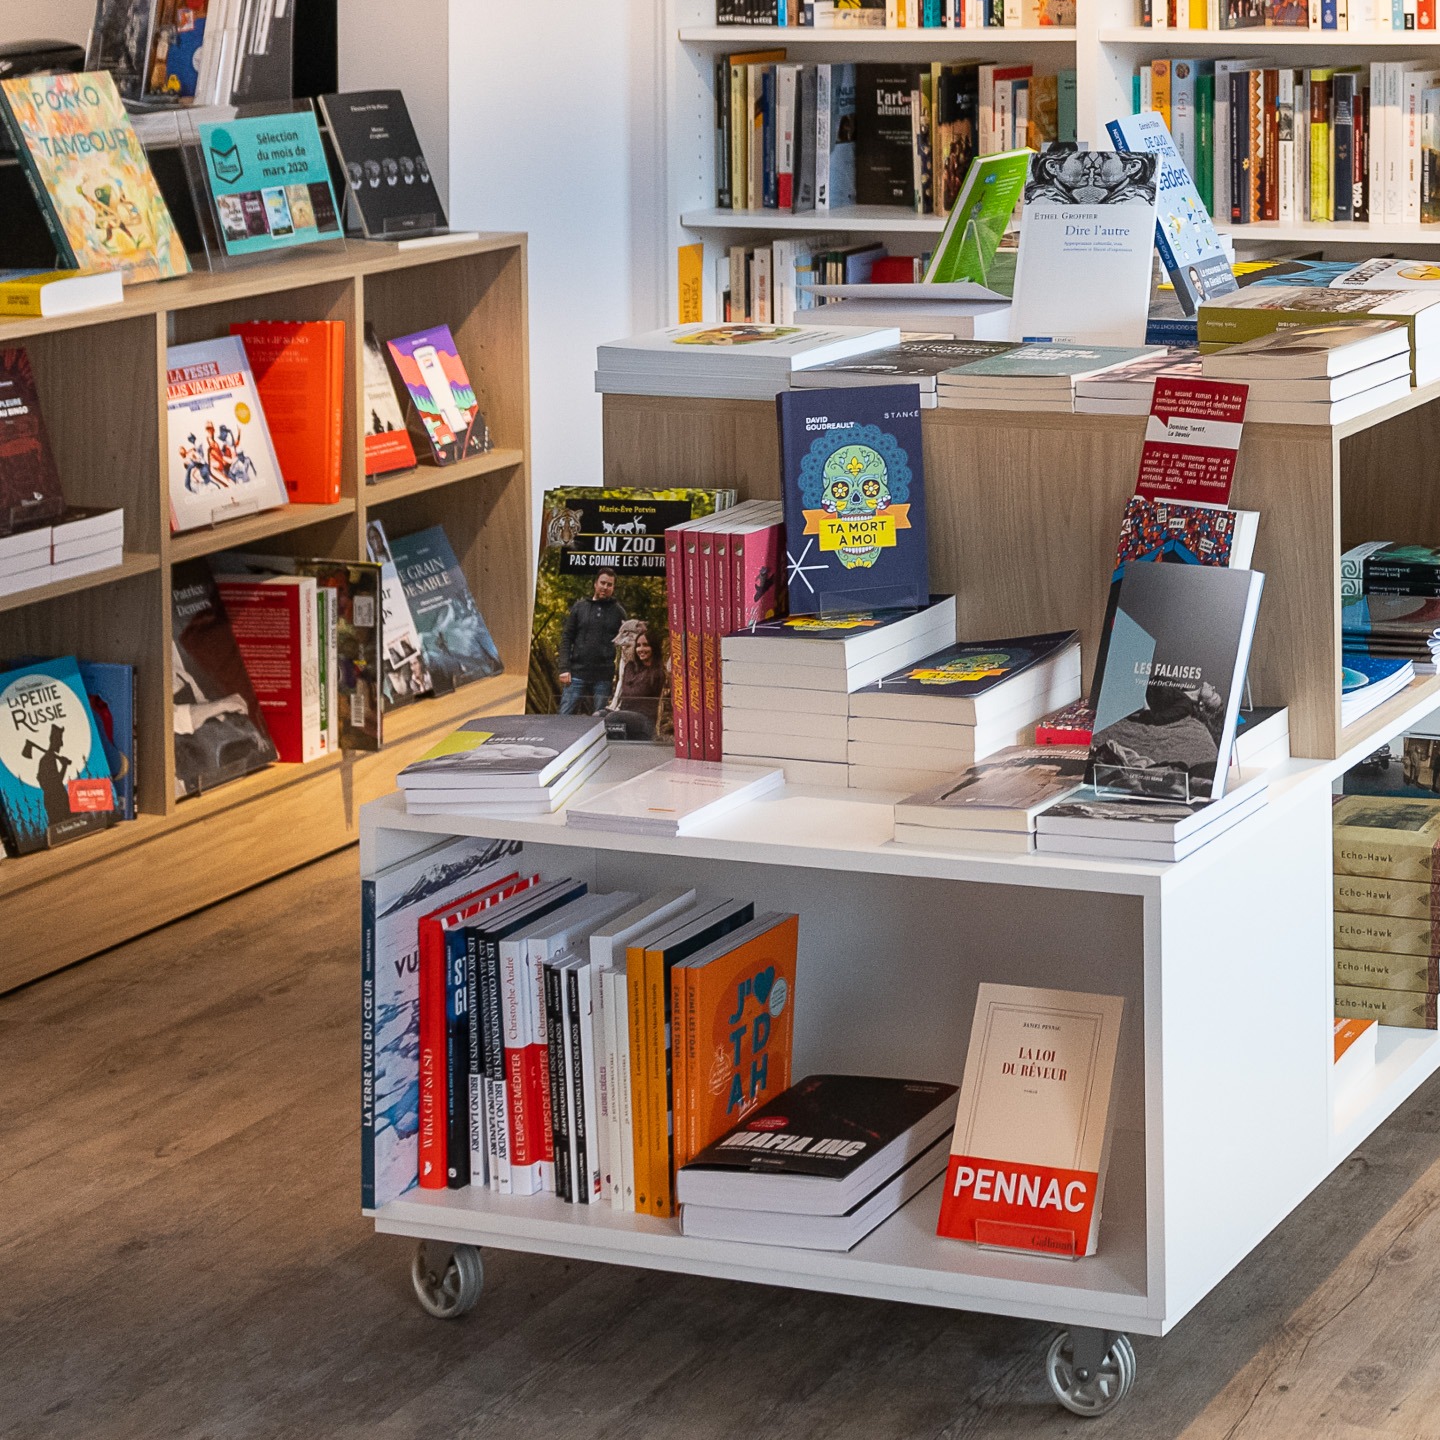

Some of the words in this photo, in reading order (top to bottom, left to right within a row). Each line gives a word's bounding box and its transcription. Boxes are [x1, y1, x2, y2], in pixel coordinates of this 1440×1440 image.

[32, 90, 100, 112] POKKO
[876, 89, 902, 106] L'art
[38, 127, 129, 157] TAMBOUR
[256, 130, 298, 145] Sélection
[257, 148, 271, 160] du
[274, 147, 292, 160] mois
[295, 146, 306, 157] de
[262, 166, 285, 177] mars
[287, 161, 308, 174] 2020
[1352, 182, 1363, 208] OKA
[1034, 212, 1057, 220] ETHEL
[1061, 212, 1098, 220] GROFFIER
[1065, 225, 1091, 237] Dire
[1094, 225, 1130, 236] l'autre
[806, 416, 828, 424] DAVID
[806, 422, 854, 431] GOUDREAULT
[599, 505, 630, 513] Marie-Ève
[632, 506, 656, 514] Potvin
[827, 523, 845, 534] TA
[848, 521, 886, 533] MORT
[594, 535, 619, 553] UN
[622, 536, 655, 553] ZOO
[852, 534, 876, 545] MOI
[569, 554, 587, 567] PAS
[588, 554, 620, 568] COMME
[622, 554, 639, 568] LES
[173, 583, 205, 601] Patrice
[176, 600, 212, 617] Demers
[1134, 662, 1151, 676] LES
[1154, 663, 1202, 680] FALAISES
[19, 683, 62, 707] PETITE
[12, 700, 67, 733] RUSSIE
[1341, 850, 1393, 863] Echo-Hawk
[1339, 888, 1391, 900] Echo-Hawk
[1339, 925, 1392, 938] Echo-Hawk
[505, 957, 515, 985] André
[1337, 962, 1389, 974] Echo-Hawk
[363, 979, 373, 1019] CŒUR
[1335, 998, 1387, 1010] Echo-Hawk
[506, 989, 520, 1040] Christophe
[363, 1022, 372, 1040] DU
[363, 1044, 372, 1071] VUE
[1018, 1047, 1032, 1060] LA
[1036, 1048, 1056, 1062] LOI
[511, 1054, 522, 1097] MÉDITER
[1001, 1062, 1017, 1075] DU
[1021, 1062, 1067, 1081] RÊVEUR
[363, 1073, 372, 1109] TERRE
[514, 1099, 523, 1113] DE
[363, 1112, 372, 1127] LA
[515, 1115, 525, 1147] TEMPS
[718, 1132, 807, 1151] MAFIA
[813, 1138, 867, 1157] INC
[517, 1150, 526, 1161] LE
[953, 1165, 1087, 1213] PENNAC
